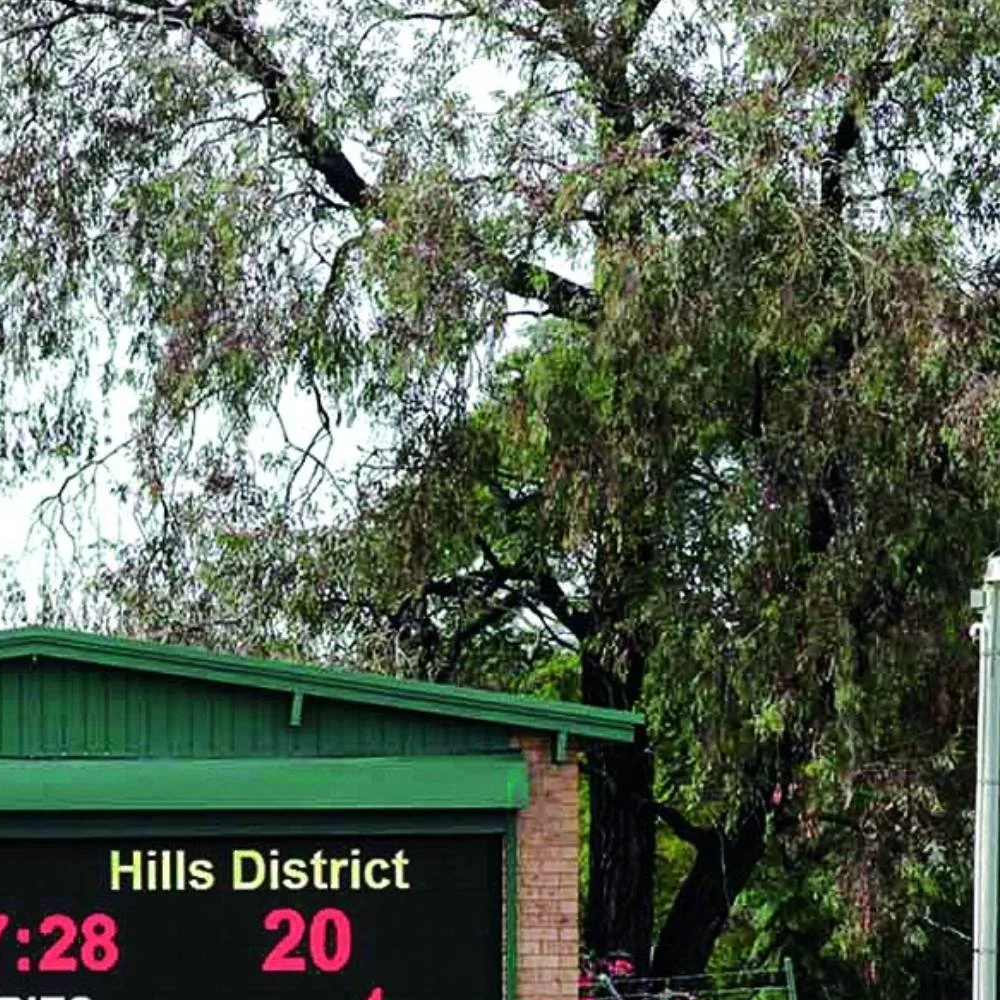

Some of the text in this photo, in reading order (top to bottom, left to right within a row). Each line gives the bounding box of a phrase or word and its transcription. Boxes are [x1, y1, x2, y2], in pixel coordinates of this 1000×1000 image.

[110, 848, 410, 891] Hills District
[261, 907, 352, 972] 20
